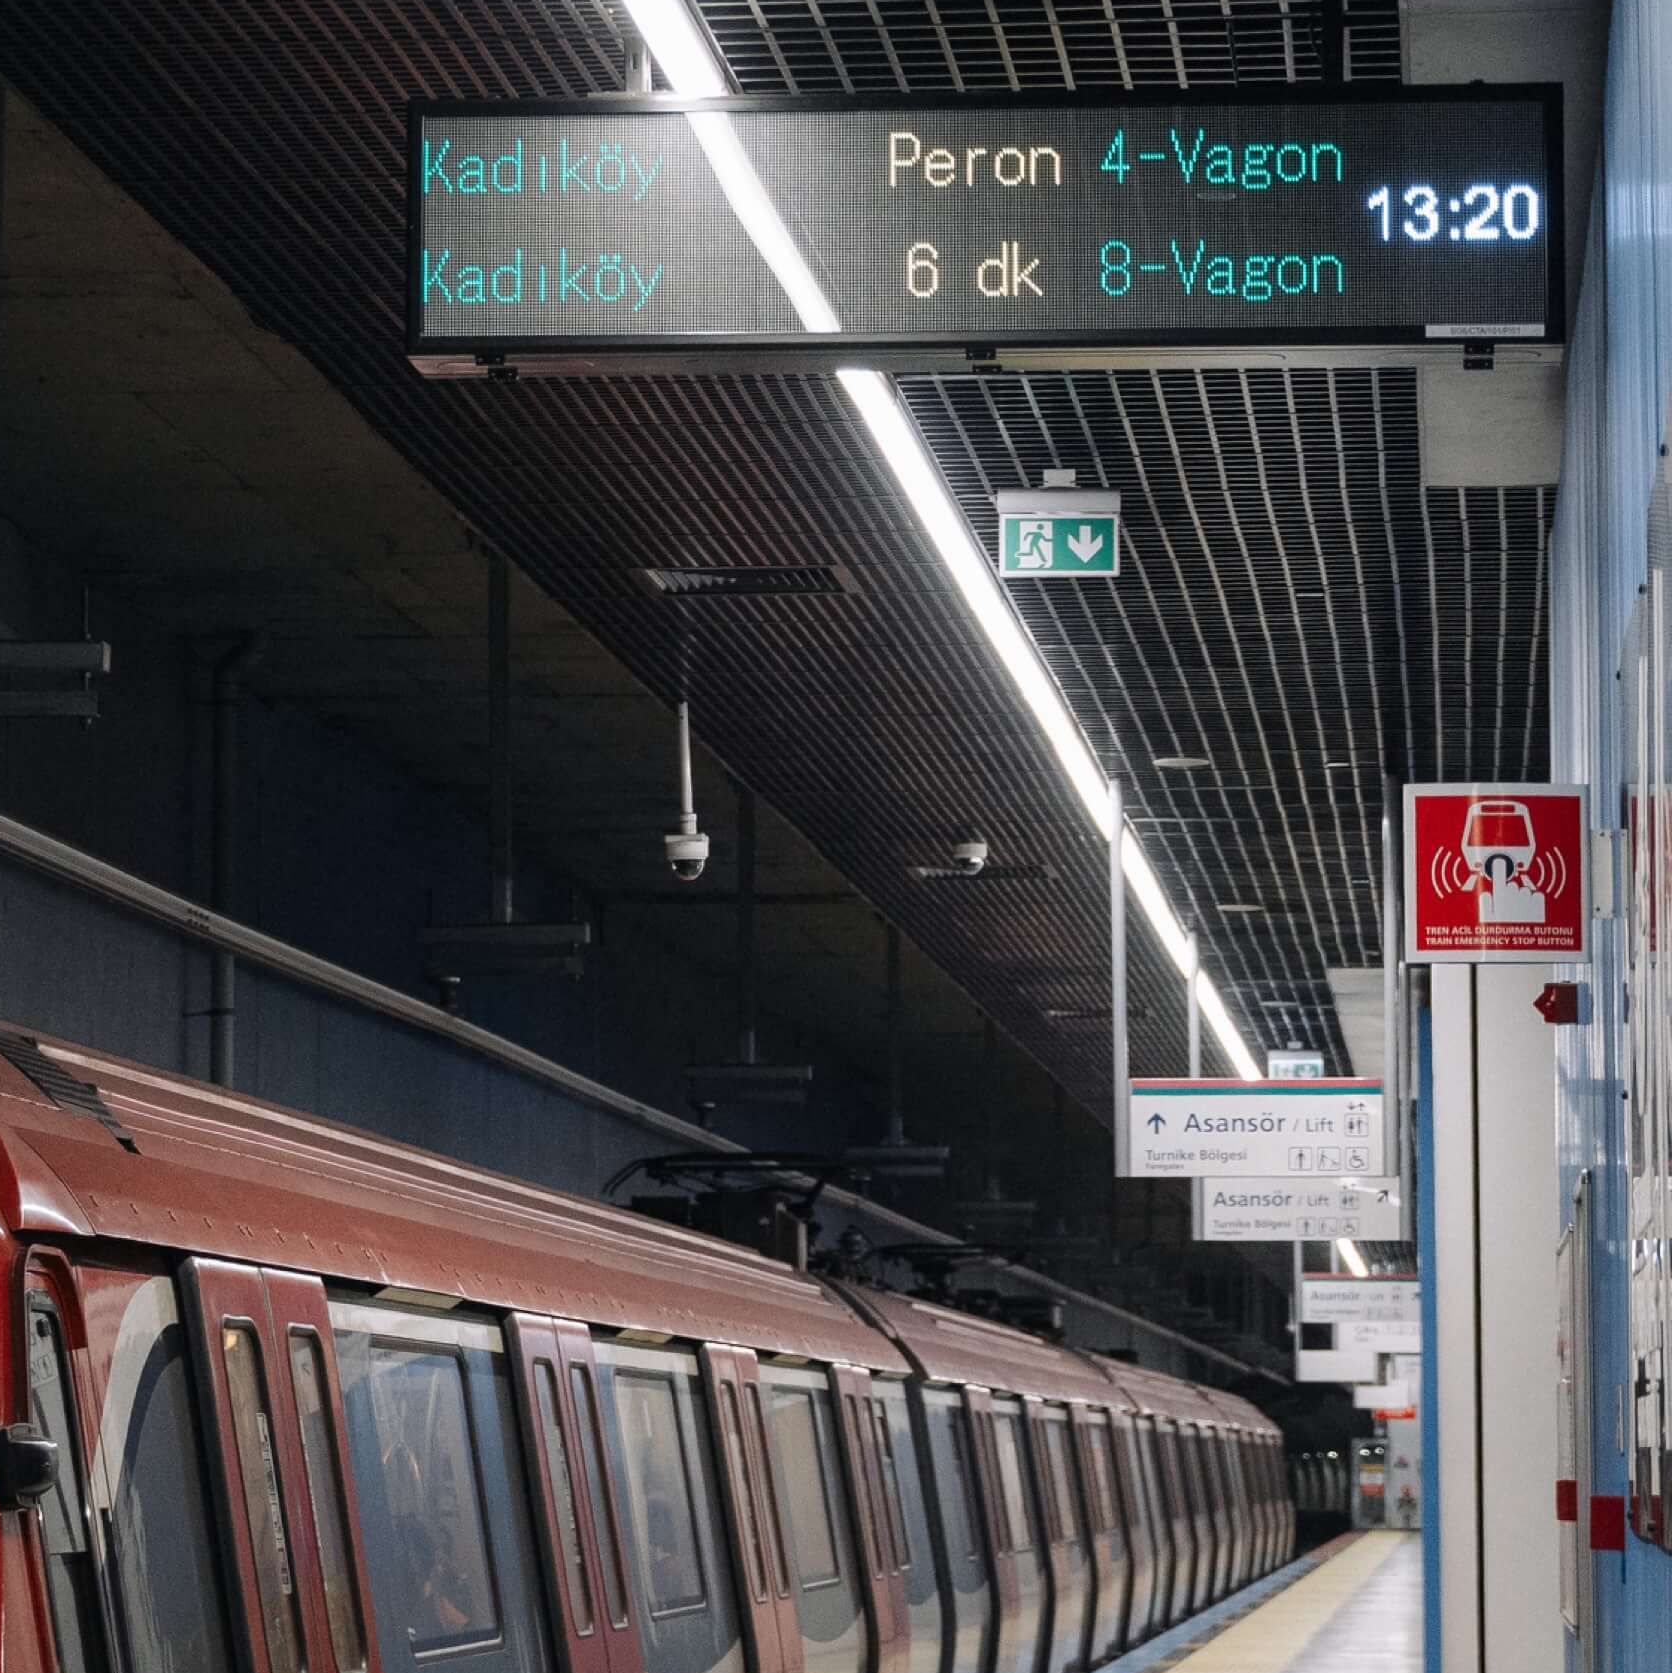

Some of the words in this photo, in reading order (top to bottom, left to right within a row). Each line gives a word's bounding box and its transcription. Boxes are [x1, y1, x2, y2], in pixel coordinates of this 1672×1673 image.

[423, 137, 664, 200] Kadıköy
[888, 131, 1062, 188] Peron
[1100, 129, 1344, 190] 4-Vagon
[1368, 184, 1540, 242] 13:20
[423, 248, 664, 312] Kadıköy
[907, 242, 939, 298] 6
[977, 240, 1044, 298] dk
[1100, 239, 1345, 302] 8-Vagon
[1425, 925, 1449, 935] TREN
[1475, 925, 1531, 935] DURDURMA
[1534, 925, 1574, 935] BUTONU
[1425, 936, 1453, 945] TRAIN
[1454, 936, 1510, 945] EMERGENCY
[1512, 936, 1535, 945] STOP
[1537, 936, 1575, 946] BUTTON
[1184, 1111, 1286, 1133] Asansör
[1305, 1118, 1334, 1133] Lift
[1145, 1148, 1196, 1161] Turnike
[1199, 1147, 1248, 1163] Bölgesi
[1213, 1190, 1293, 1207] Asansör
[1307, 1193, 1331, 1207] Lift
